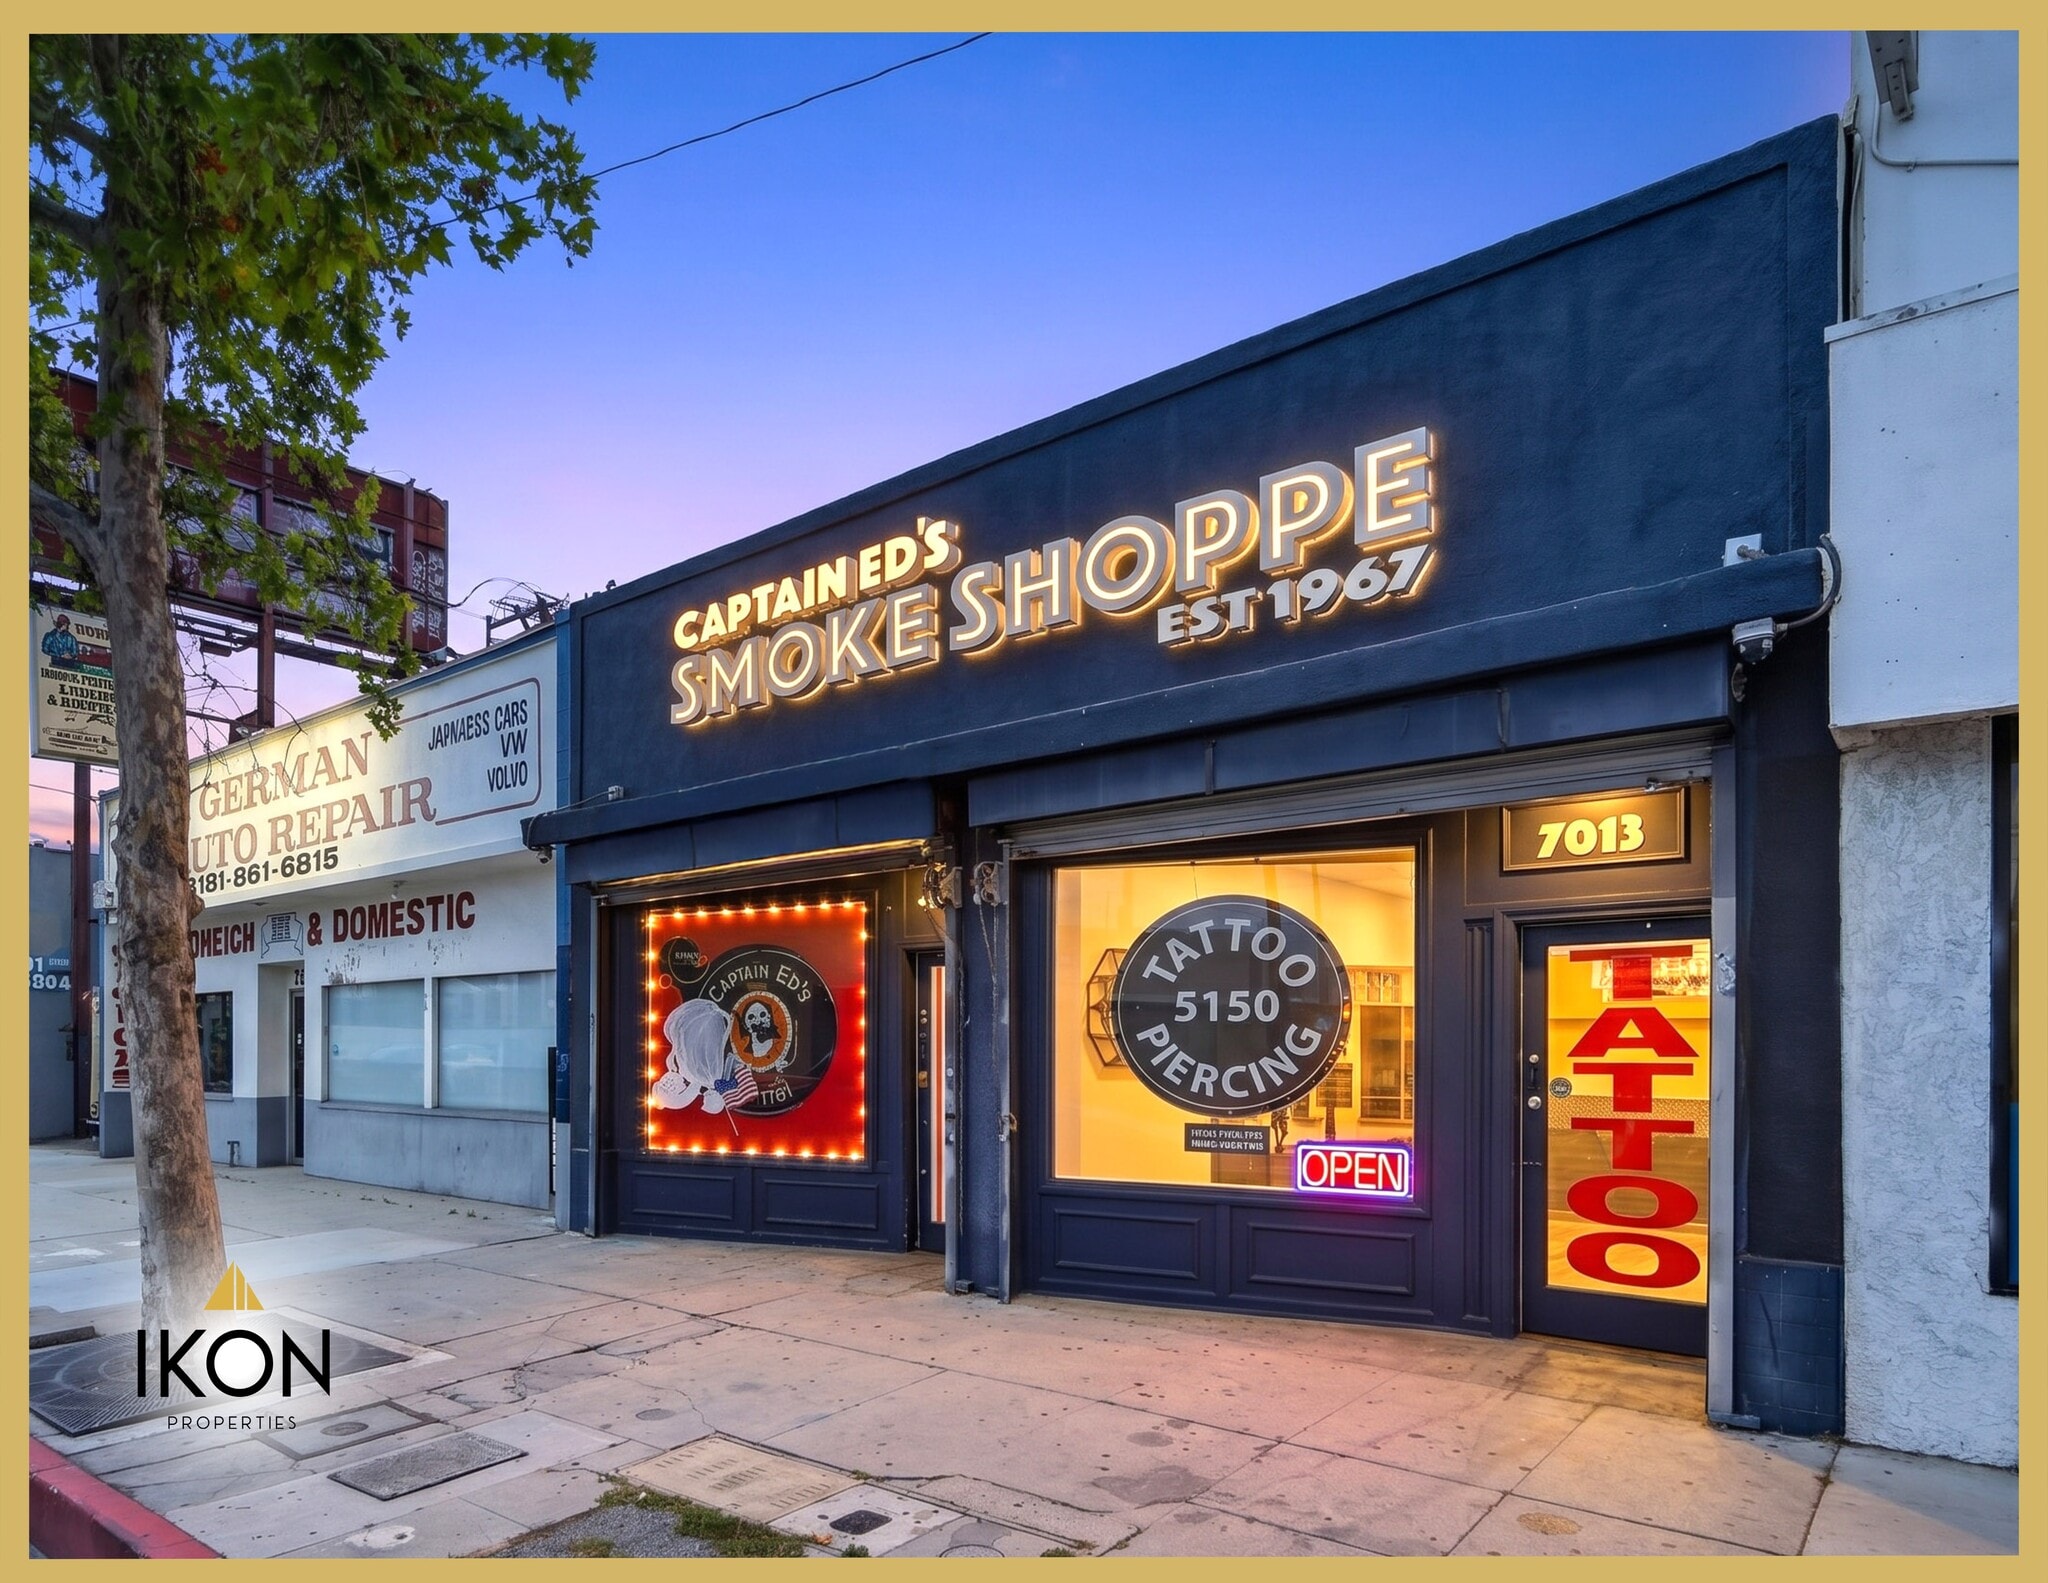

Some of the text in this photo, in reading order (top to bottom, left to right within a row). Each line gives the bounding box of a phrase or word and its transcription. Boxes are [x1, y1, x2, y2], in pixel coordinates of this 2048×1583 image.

[670, 426, 1434, 727] SMOKE SHOPPE
[673, 516, 962, 651] CAPTAIN ED'S
[1157, 544, 1436, 647] EST 1967
[494, 699, 528, 732] CARS
[500, 728, 528, 758] VW
[199, 731, 373, 822] GERMAN
[487, 760, 528, 792] VOLVO
[188, 776, 437, 875] UTO REPAIR
[1536, 813, 1646, 859] 7013
[307, 891, 476, 947] & DOMESTIC
[1142, 918, 1316, 987] TATTOO
[1174, 989, 1280, 1023] 5150
[1136, 1023, 1322, 1098] PIERCING
[1566, 944, 1701, 1289] TATTOO
[1302, 1150, 1403, 1191] OPEN
